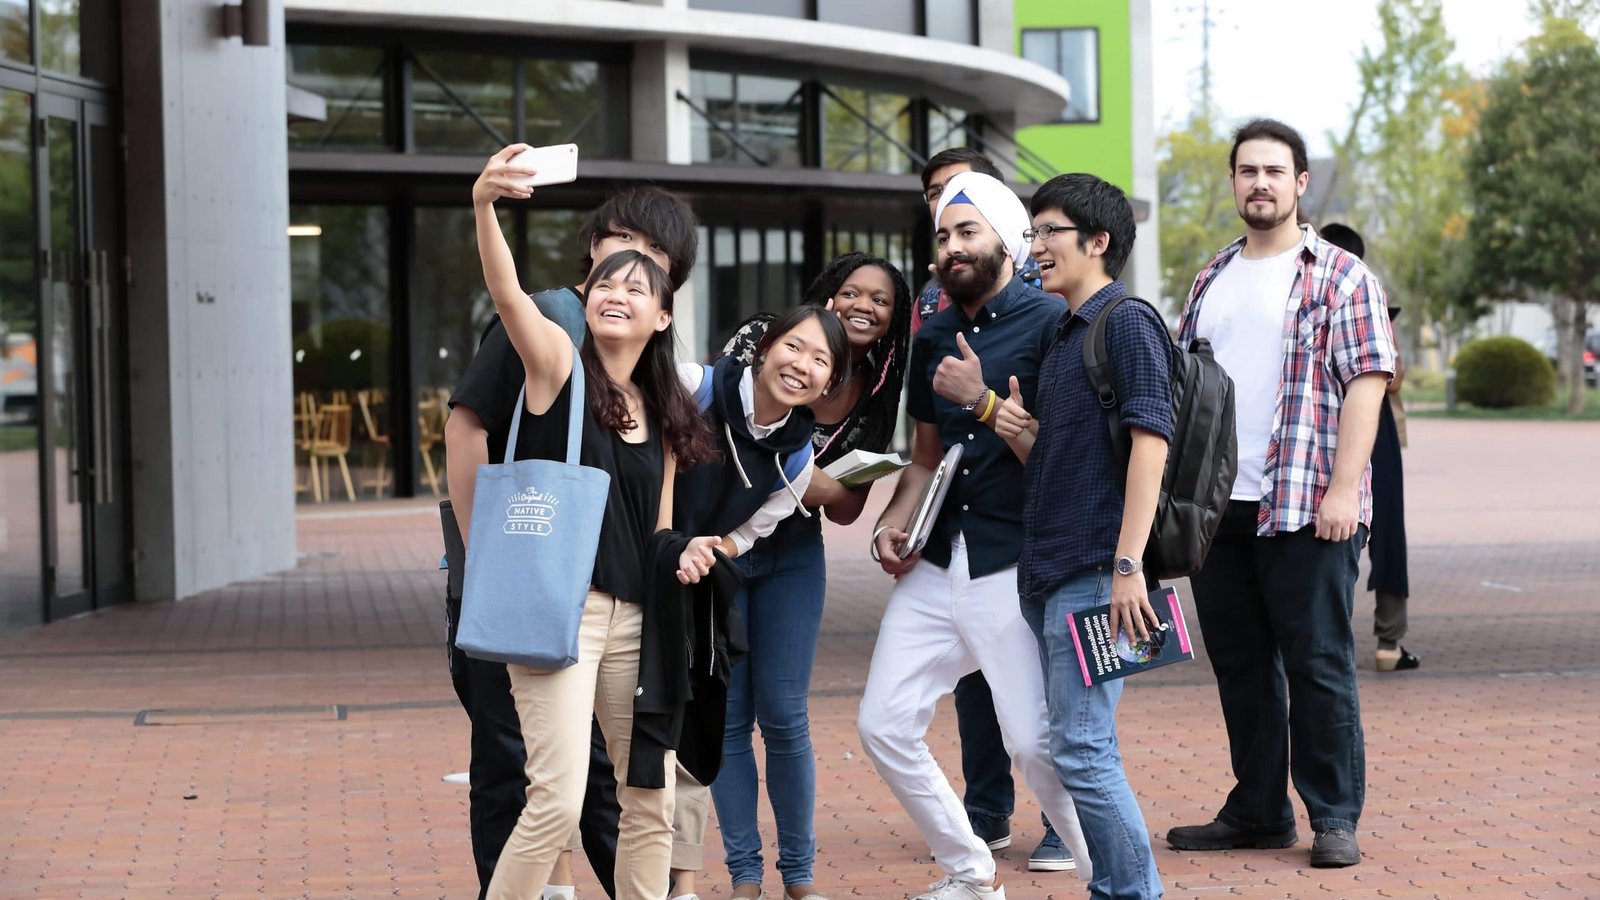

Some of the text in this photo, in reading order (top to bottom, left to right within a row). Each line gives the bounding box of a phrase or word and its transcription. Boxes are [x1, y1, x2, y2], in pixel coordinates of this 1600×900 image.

[511, 523, 542, 531] STYLE
[1092, 615, 1105, 644] Education
[1101, 613, 1111, 638] Mobility
[1084, 617, 1104, 675] Internationalisation
[1100, 645, 1111, 665] Higher
[1112, 658, 1121, 670] and
